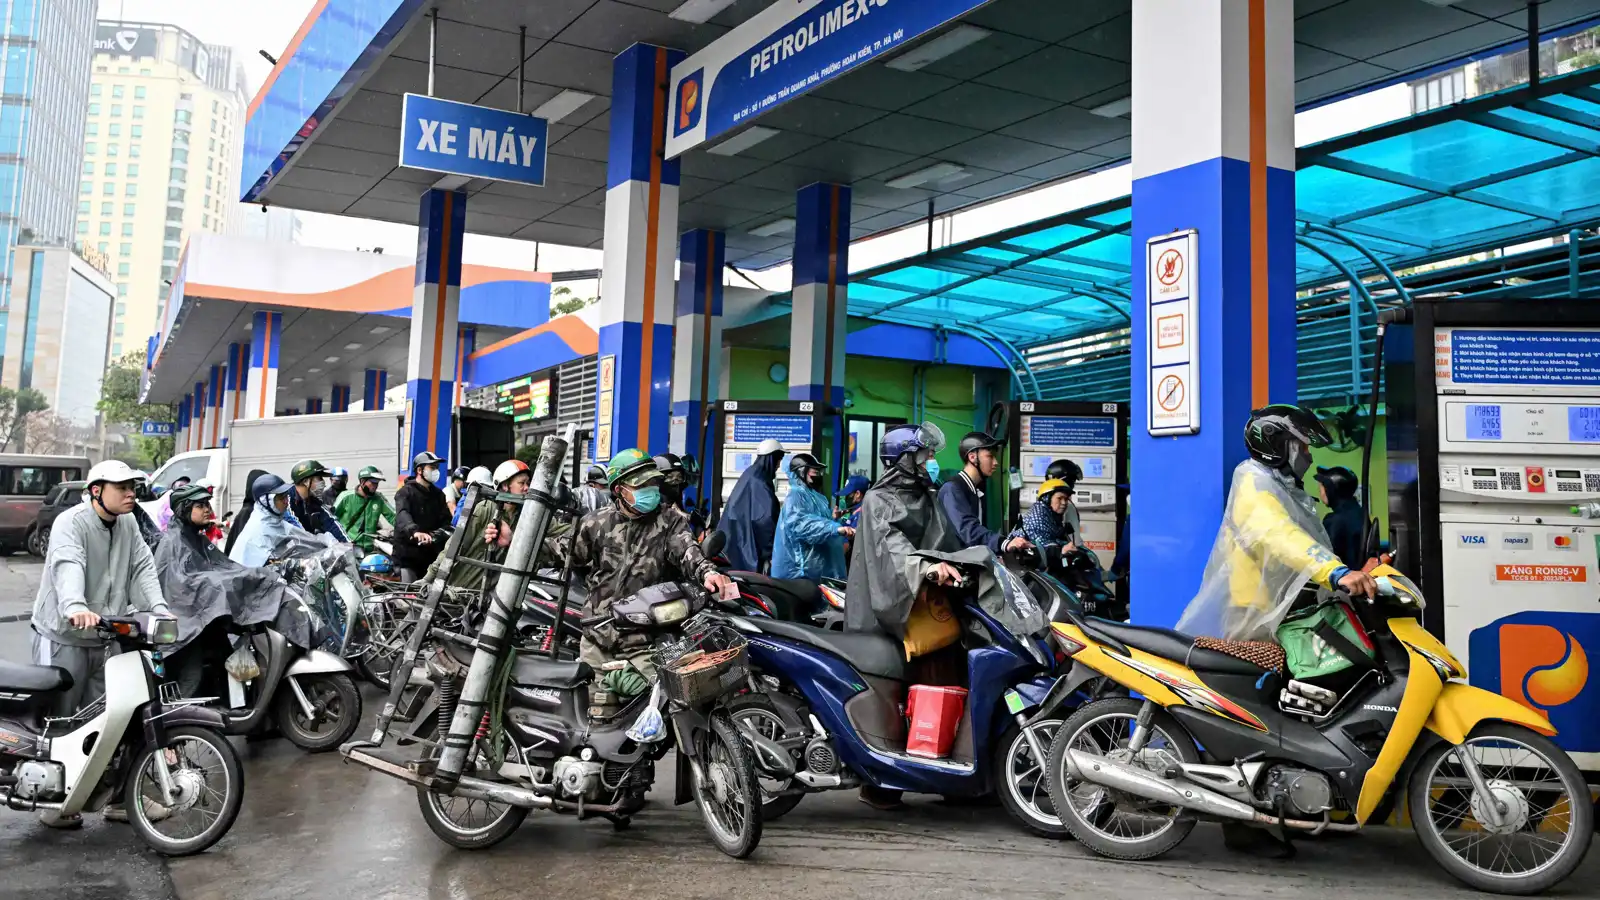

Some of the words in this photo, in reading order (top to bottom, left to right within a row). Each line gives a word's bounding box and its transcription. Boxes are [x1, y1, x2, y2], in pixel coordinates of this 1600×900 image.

[750, 0, 889, 78] PETROLIMEX-
[883, 33, 892, 46] HÀ
[93, 38, 117, 51] ank
[416, 118, 458, 155] XE
[468, 126, 538, 168] MÁY
[1021, 403, 1032, 411] 27
[1461, 535, 1485, 544] VISA
[1504, 537, 1524, 545] napas
[1536, 566, 1580, 576] RON95-V
[1363, 704, 1398, 712] HONDA
